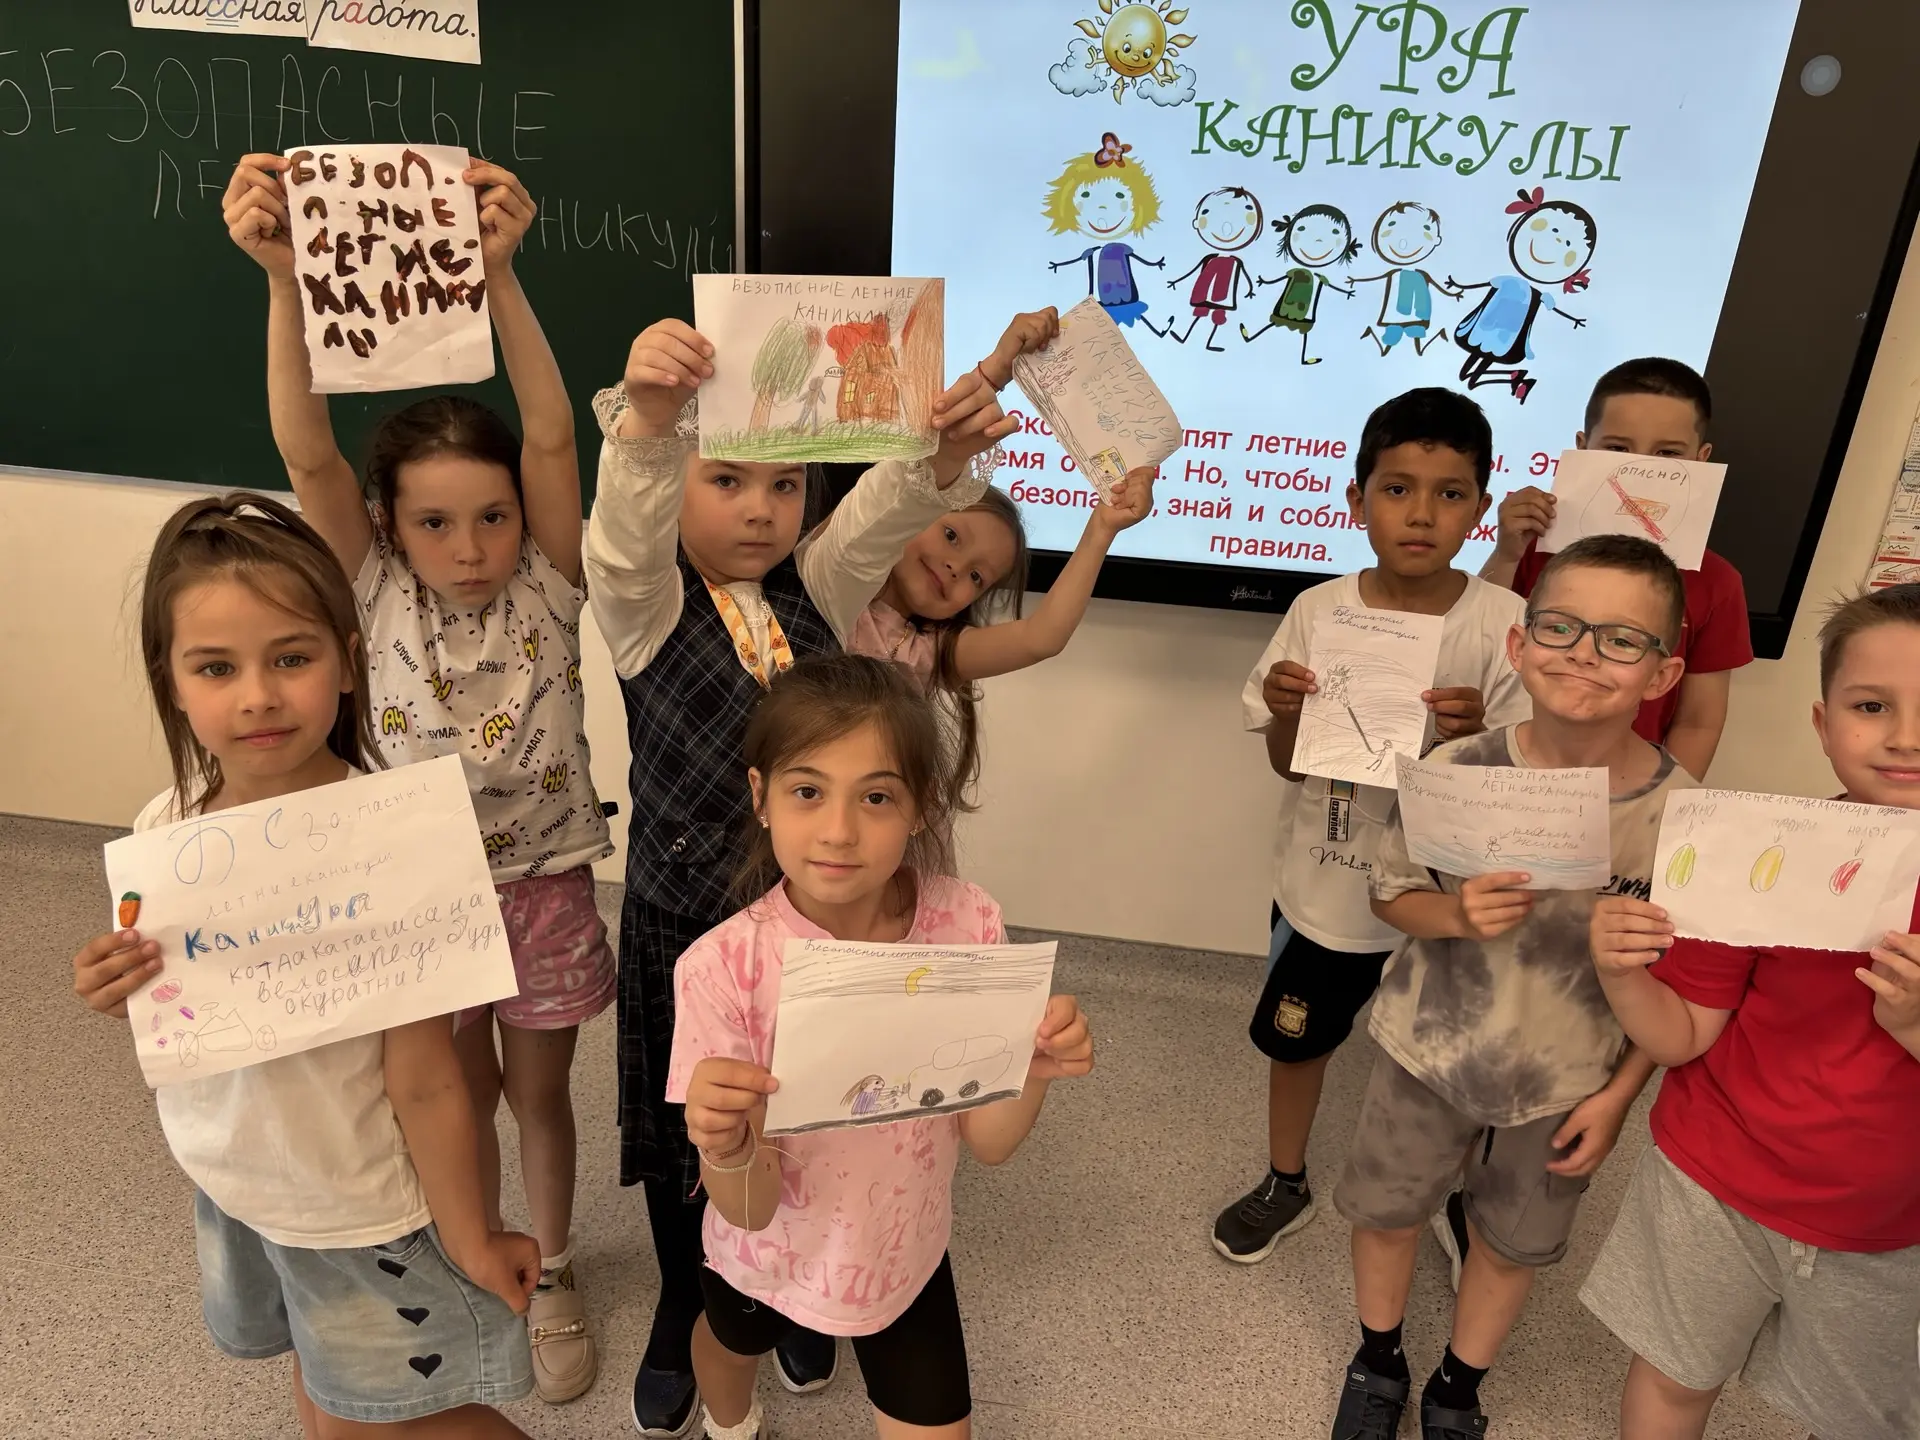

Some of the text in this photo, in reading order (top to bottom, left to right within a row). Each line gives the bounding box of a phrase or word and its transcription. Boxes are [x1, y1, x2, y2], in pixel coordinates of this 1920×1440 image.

[1290, 0, 1530, 99] УРА
[1190, 99, 1631, 182] КАНИКУЛЫ
[733, 278, 916, 299] БЕЗОПАСНЫЕ ЛЕТНИЕ
[1245, 434, 1347, 459] летние
[1184, 459, 1228, 488] Но,
[1245, 468, 1332, 493] чтобы
[1167, 497, 1233, 519] знай
[1247, 504, 1265, 522] и
[1209, 535, 1333, 562] правила.
[519, 727, 547, 769] БУМАГА
[540, 807, 577, 839] БУМАГА
